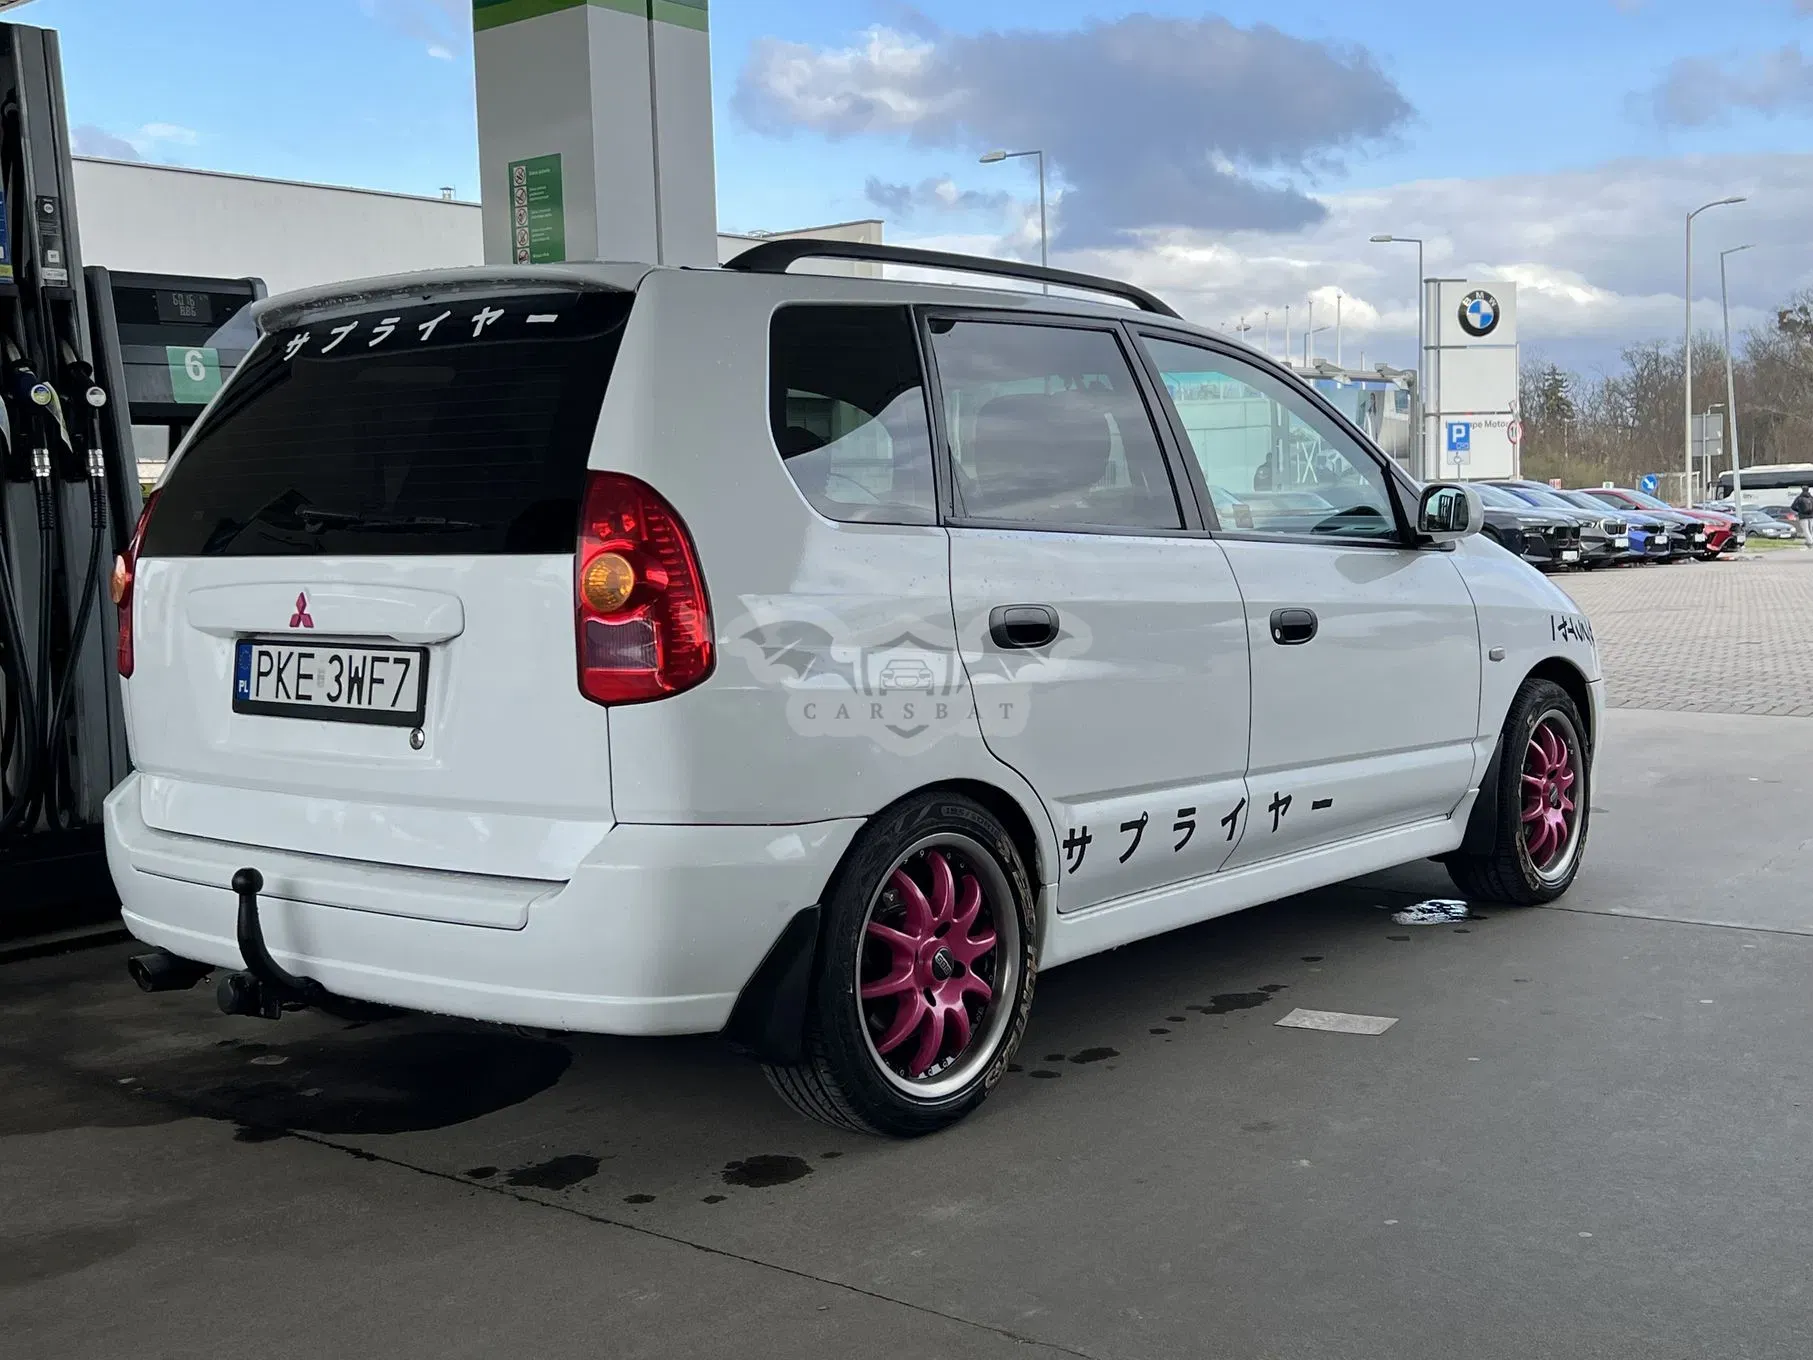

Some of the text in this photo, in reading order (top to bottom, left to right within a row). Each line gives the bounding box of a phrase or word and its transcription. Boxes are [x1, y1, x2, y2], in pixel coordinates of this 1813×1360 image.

[1462, 291, 1498, 307] BMW
[284, 306, 558, 361] サプライヤー
[184, 350, 206, 381] 6
[1452, 425, 1466, 443] P
[239, 679, 249, 693] PL
[256, 650, 411, 708] PKE 3WF7
[1062, 791, 1333, 874] サプライヤー
